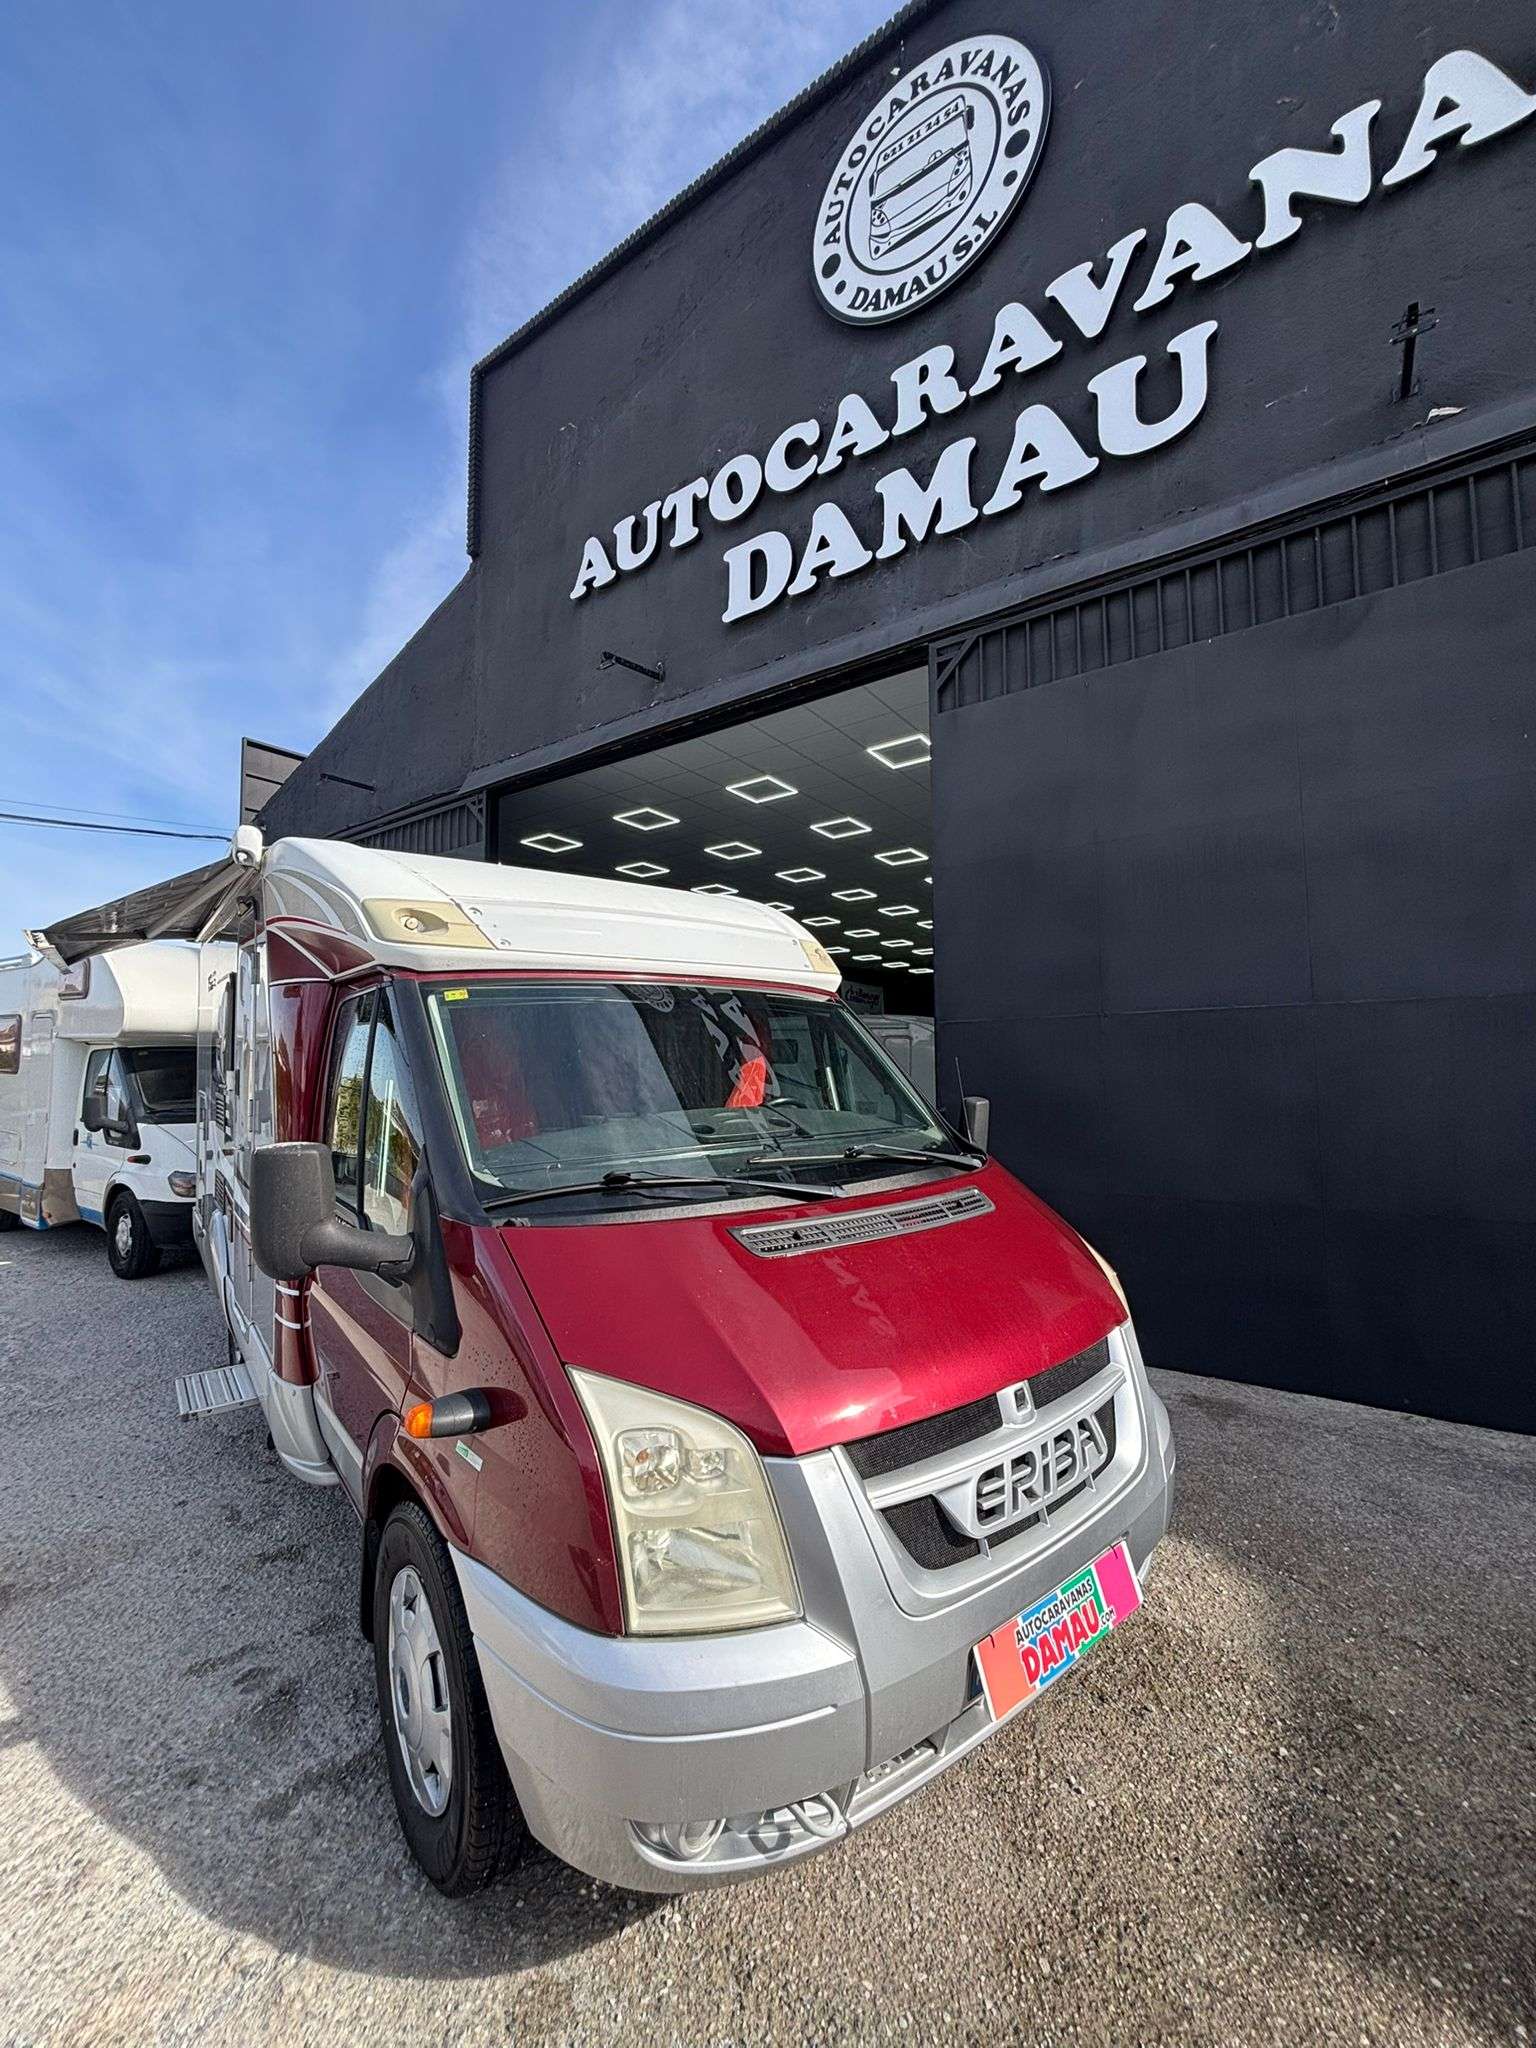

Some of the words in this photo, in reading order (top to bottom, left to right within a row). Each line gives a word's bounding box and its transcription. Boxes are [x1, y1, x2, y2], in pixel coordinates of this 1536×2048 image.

[823, 49, 1031, 247] AUTOCARAVANAS
[882, 142, 904, 162] 621
[907, 129, 922, 146] 21
[925, 115, 941, 132] 24
[943, 101, 959, 120] 54
[847, 254, 948, 312] DAMAU
[721, 319, 1219, 624] DAMAU
[975, 1414, 1108, 1529] ERIBA
[1015, 1578, 1093, 1646] AUTOCARAVANAS
[1020, 1598, 1100, 1685] DAMAU
